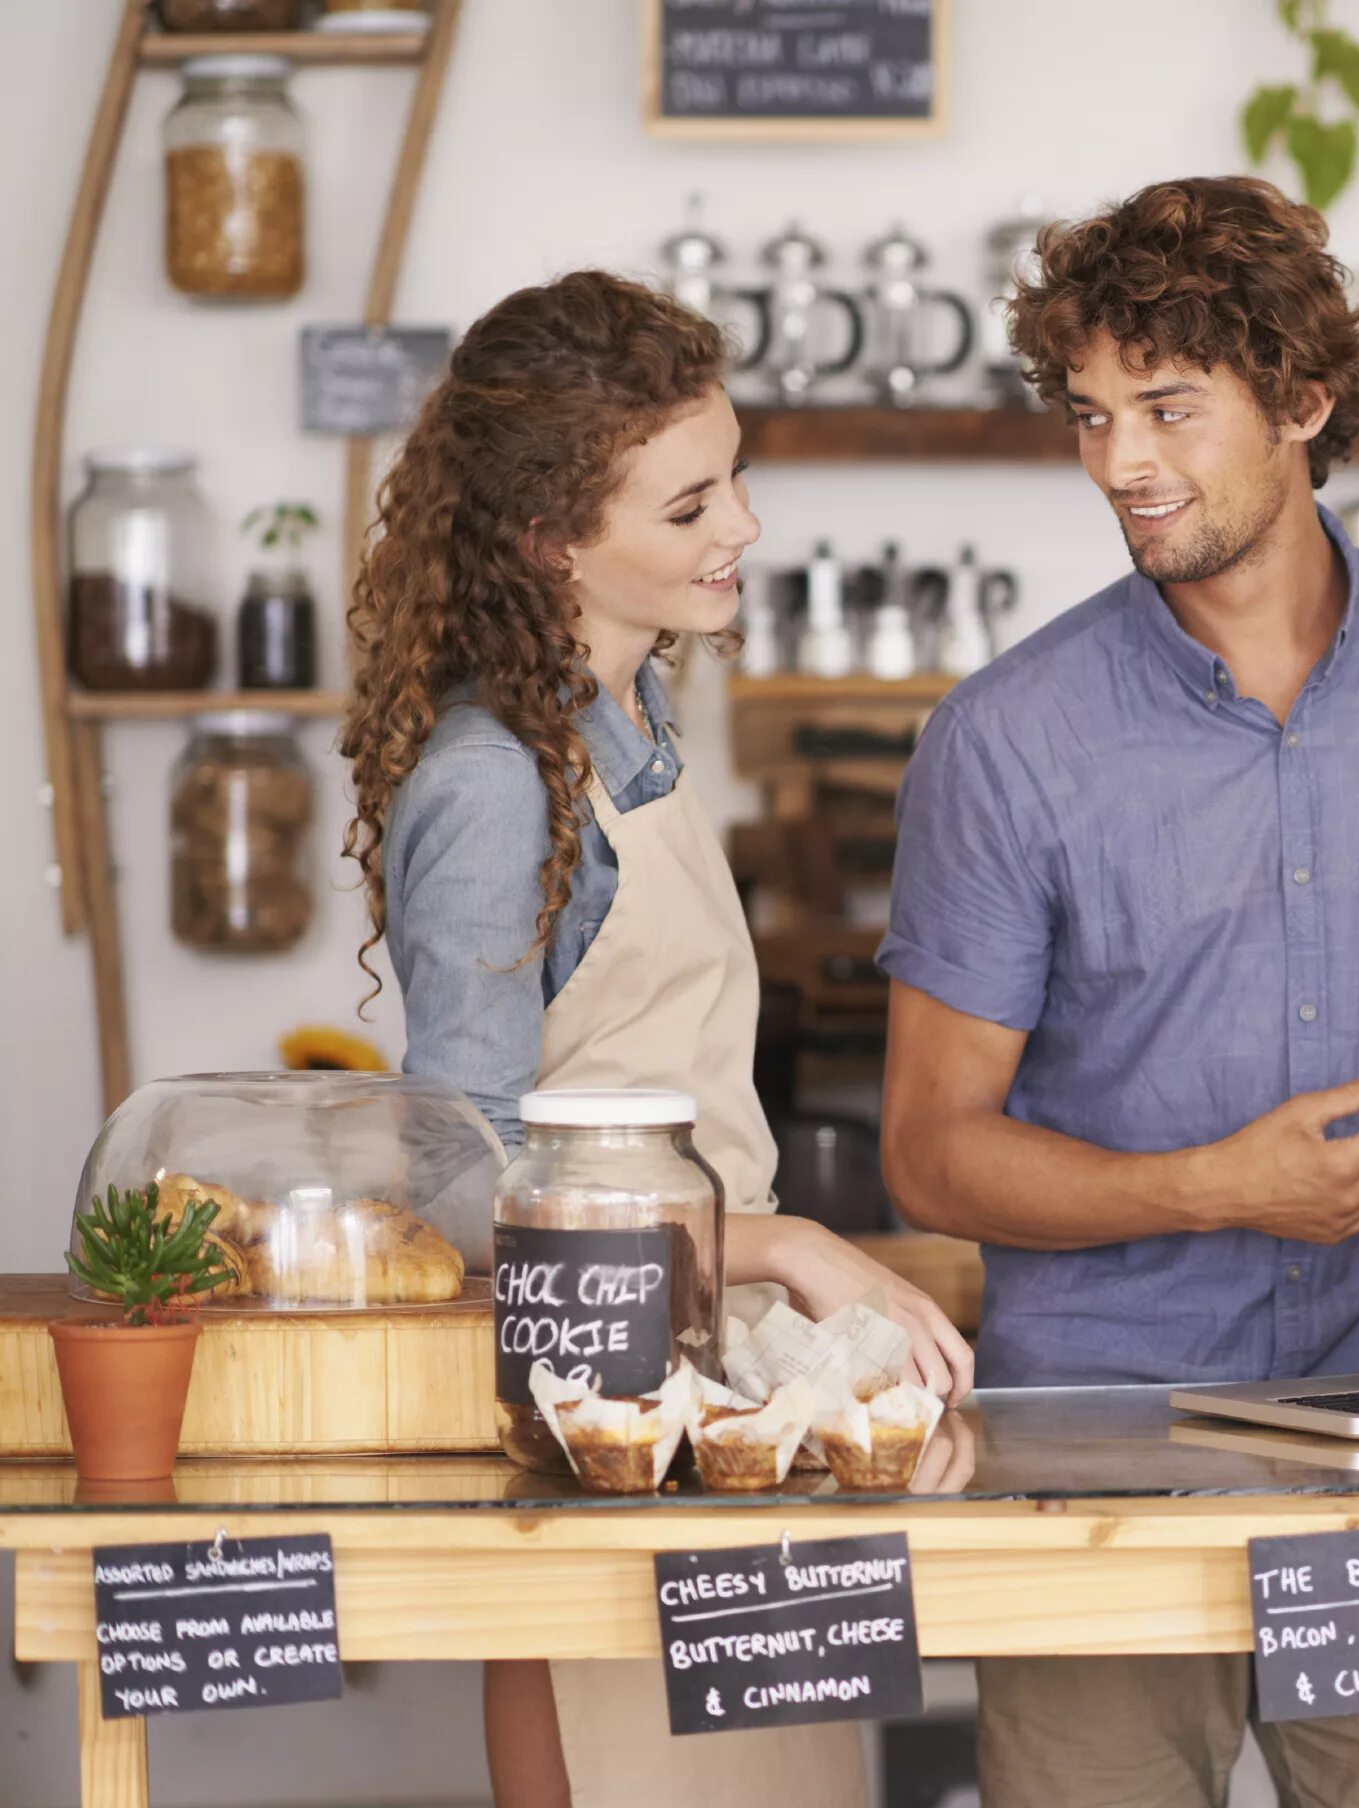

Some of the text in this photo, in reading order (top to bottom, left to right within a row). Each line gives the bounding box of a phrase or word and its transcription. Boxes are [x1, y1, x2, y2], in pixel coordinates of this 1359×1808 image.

[495, 1261, 664, 1307] CHOC CHIP
[501, 1316, 630, 1357] COOKIE
[94, 1561, 175, 1586] ASSORTED
[660, 1558, 907, 1607] CHEESY BUTTERNUT
[1254, 1565, 1314, 1599] THE
[96, 1609, 336, 1645] CHOOSE FROM AVAILABLE
[669, 1617, 905, 1670] BUTTERNUT, CHEESE
[101, 1643, 338, 1675] OPTIONS OR CREATE
[114, 1675, 268, 1711] YOUR OWN.
[743, 1675, 871, 1709] CINNAMON
